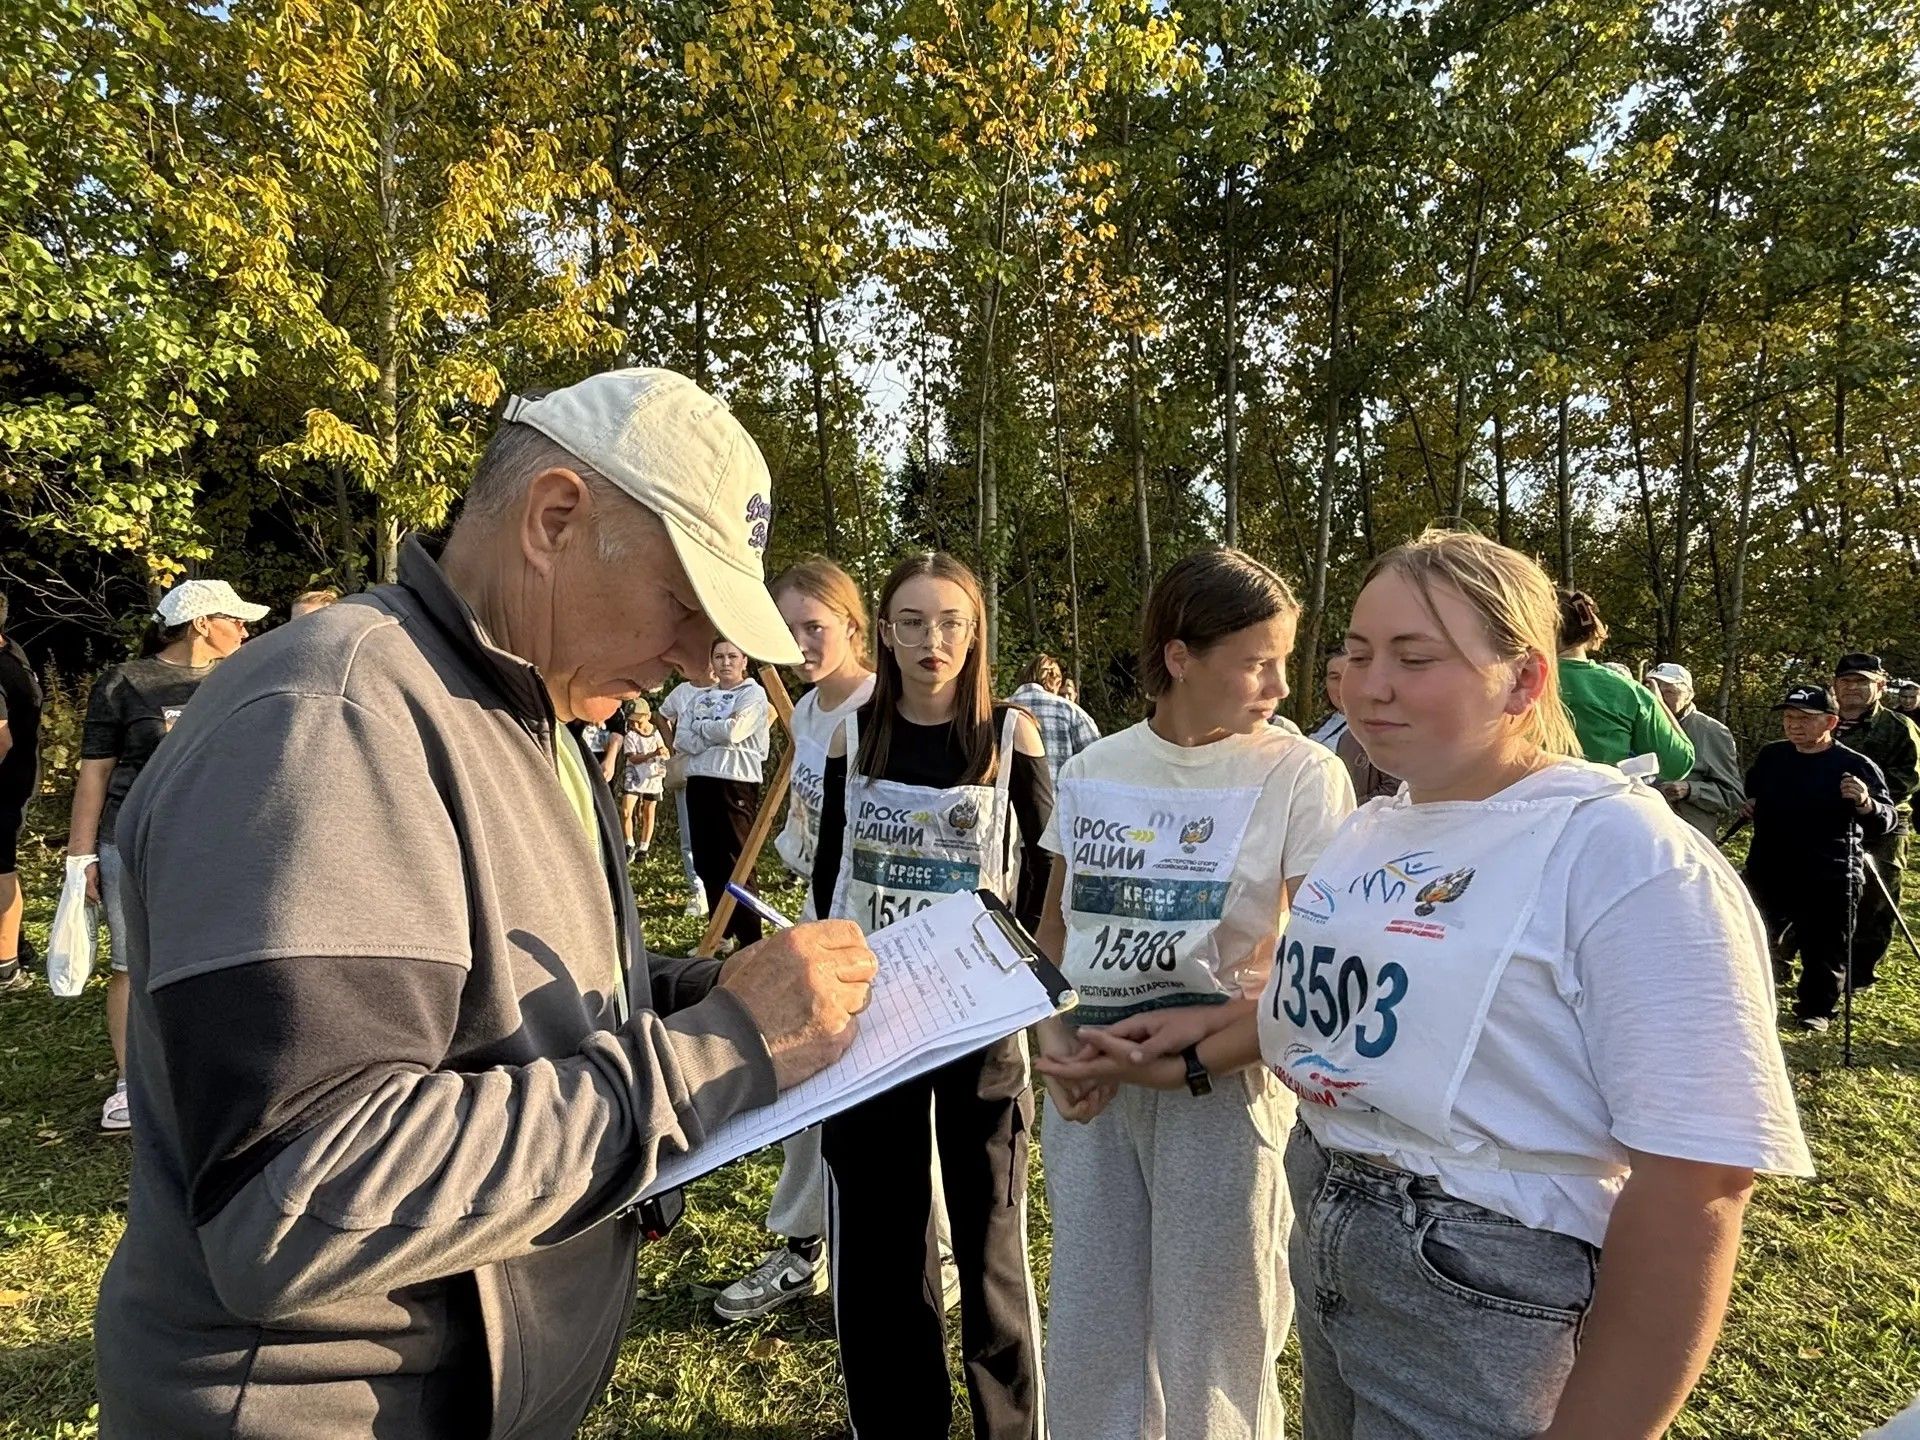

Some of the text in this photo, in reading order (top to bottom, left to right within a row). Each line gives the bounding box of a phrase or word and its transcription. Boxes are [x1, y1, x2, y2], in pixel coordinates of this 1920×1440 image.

[854, 820, 924, 846] НАЦИИ
[1073, 841, 1146, 870] АЦИИ
[888, 863, 933, 880] КРОСС
[888, 876, 932, 886] НАЦИИ
[1123, 885, 1177, 905] КРОСС
[1123, 902, 1176, 913] НАЦИИ
[1089, 925, 1187, 972] 15388
[1080, 984, 1129, 998] РЕСПУБЛИКА
[1128, 981, 1186, 996] ТАТАРСТАН
[1272, 934, 1409, 1059] 13503
